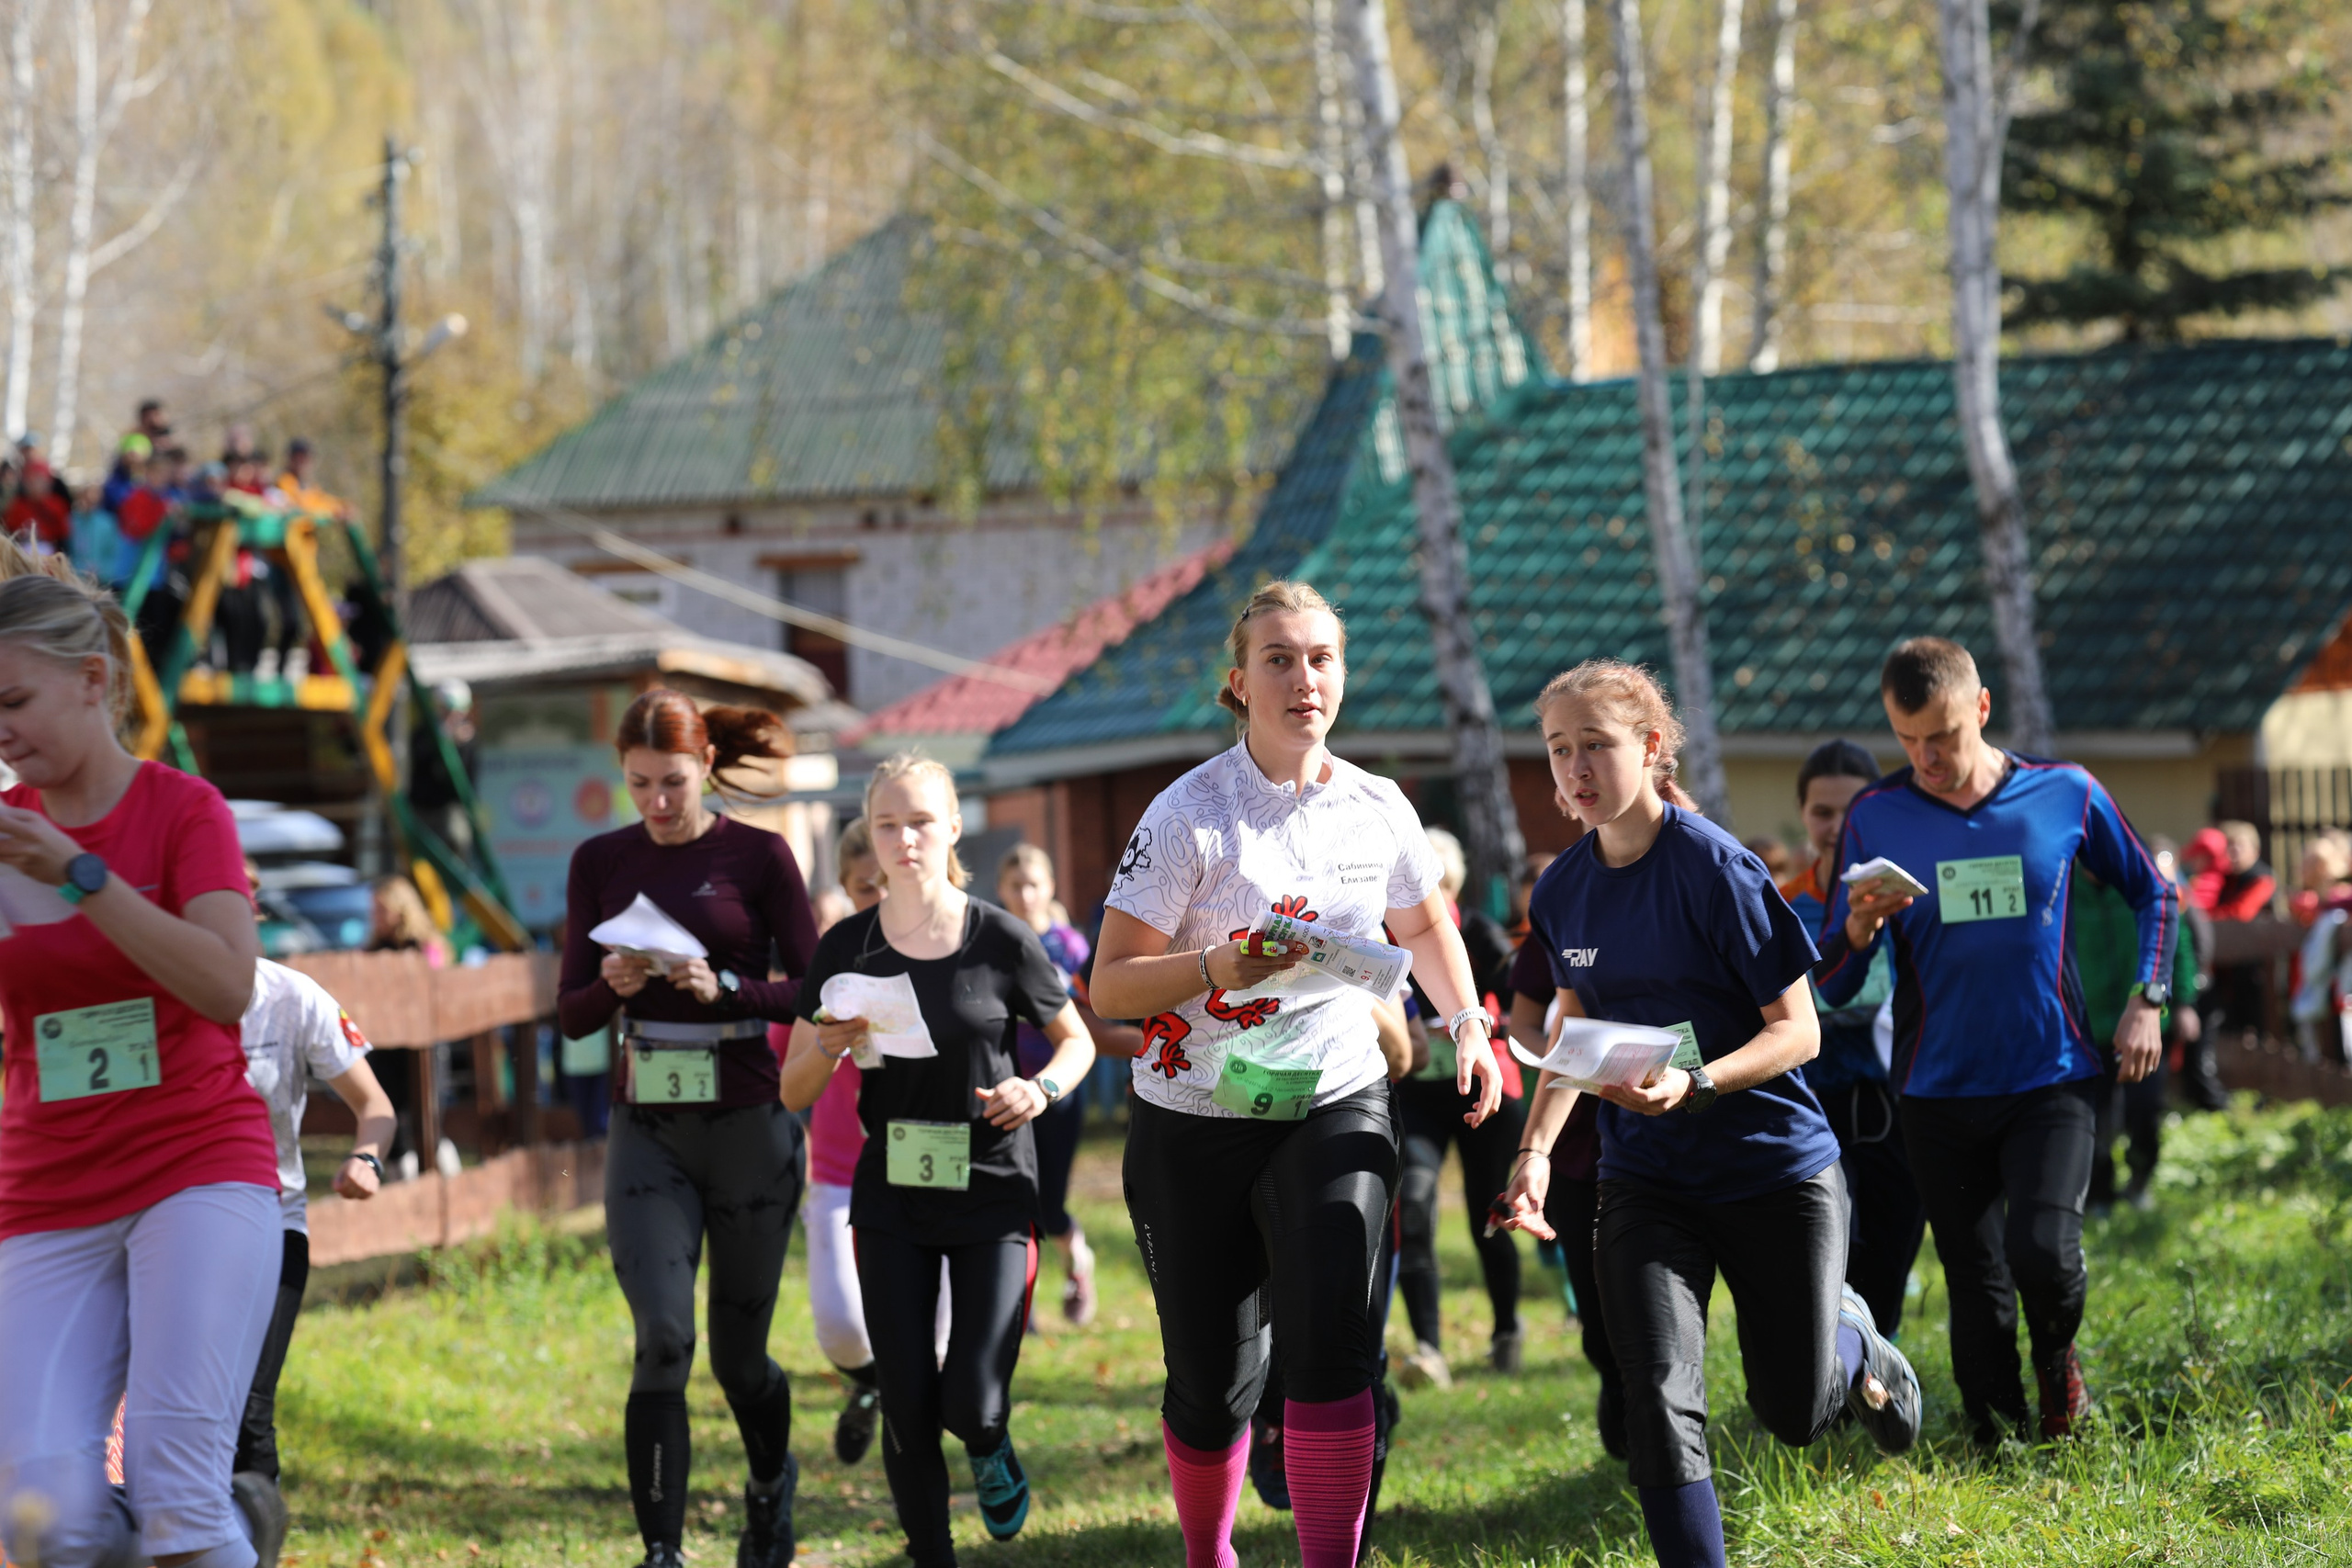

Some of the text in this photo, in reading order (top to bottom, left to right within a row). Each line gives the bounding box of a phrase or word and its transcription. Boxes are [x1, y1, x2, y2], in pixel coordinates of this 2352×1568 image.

[1970, 887, 1993, 916] 11
[2008, 894, 2017, 912] 2
[1361, 970, 1373, 981] 9.1
[88, 1047, 109, 1090] 2
[140, 1053, 150, 1081] 1
[667, 1072, 682, 1099] 3
[1250, 1092, 1273, 1115] 9
[1294, 1100, 1302, 1118] 1
[920, 1154, 933, 1183] 3
[956, 1164, 961, 1183] 1
